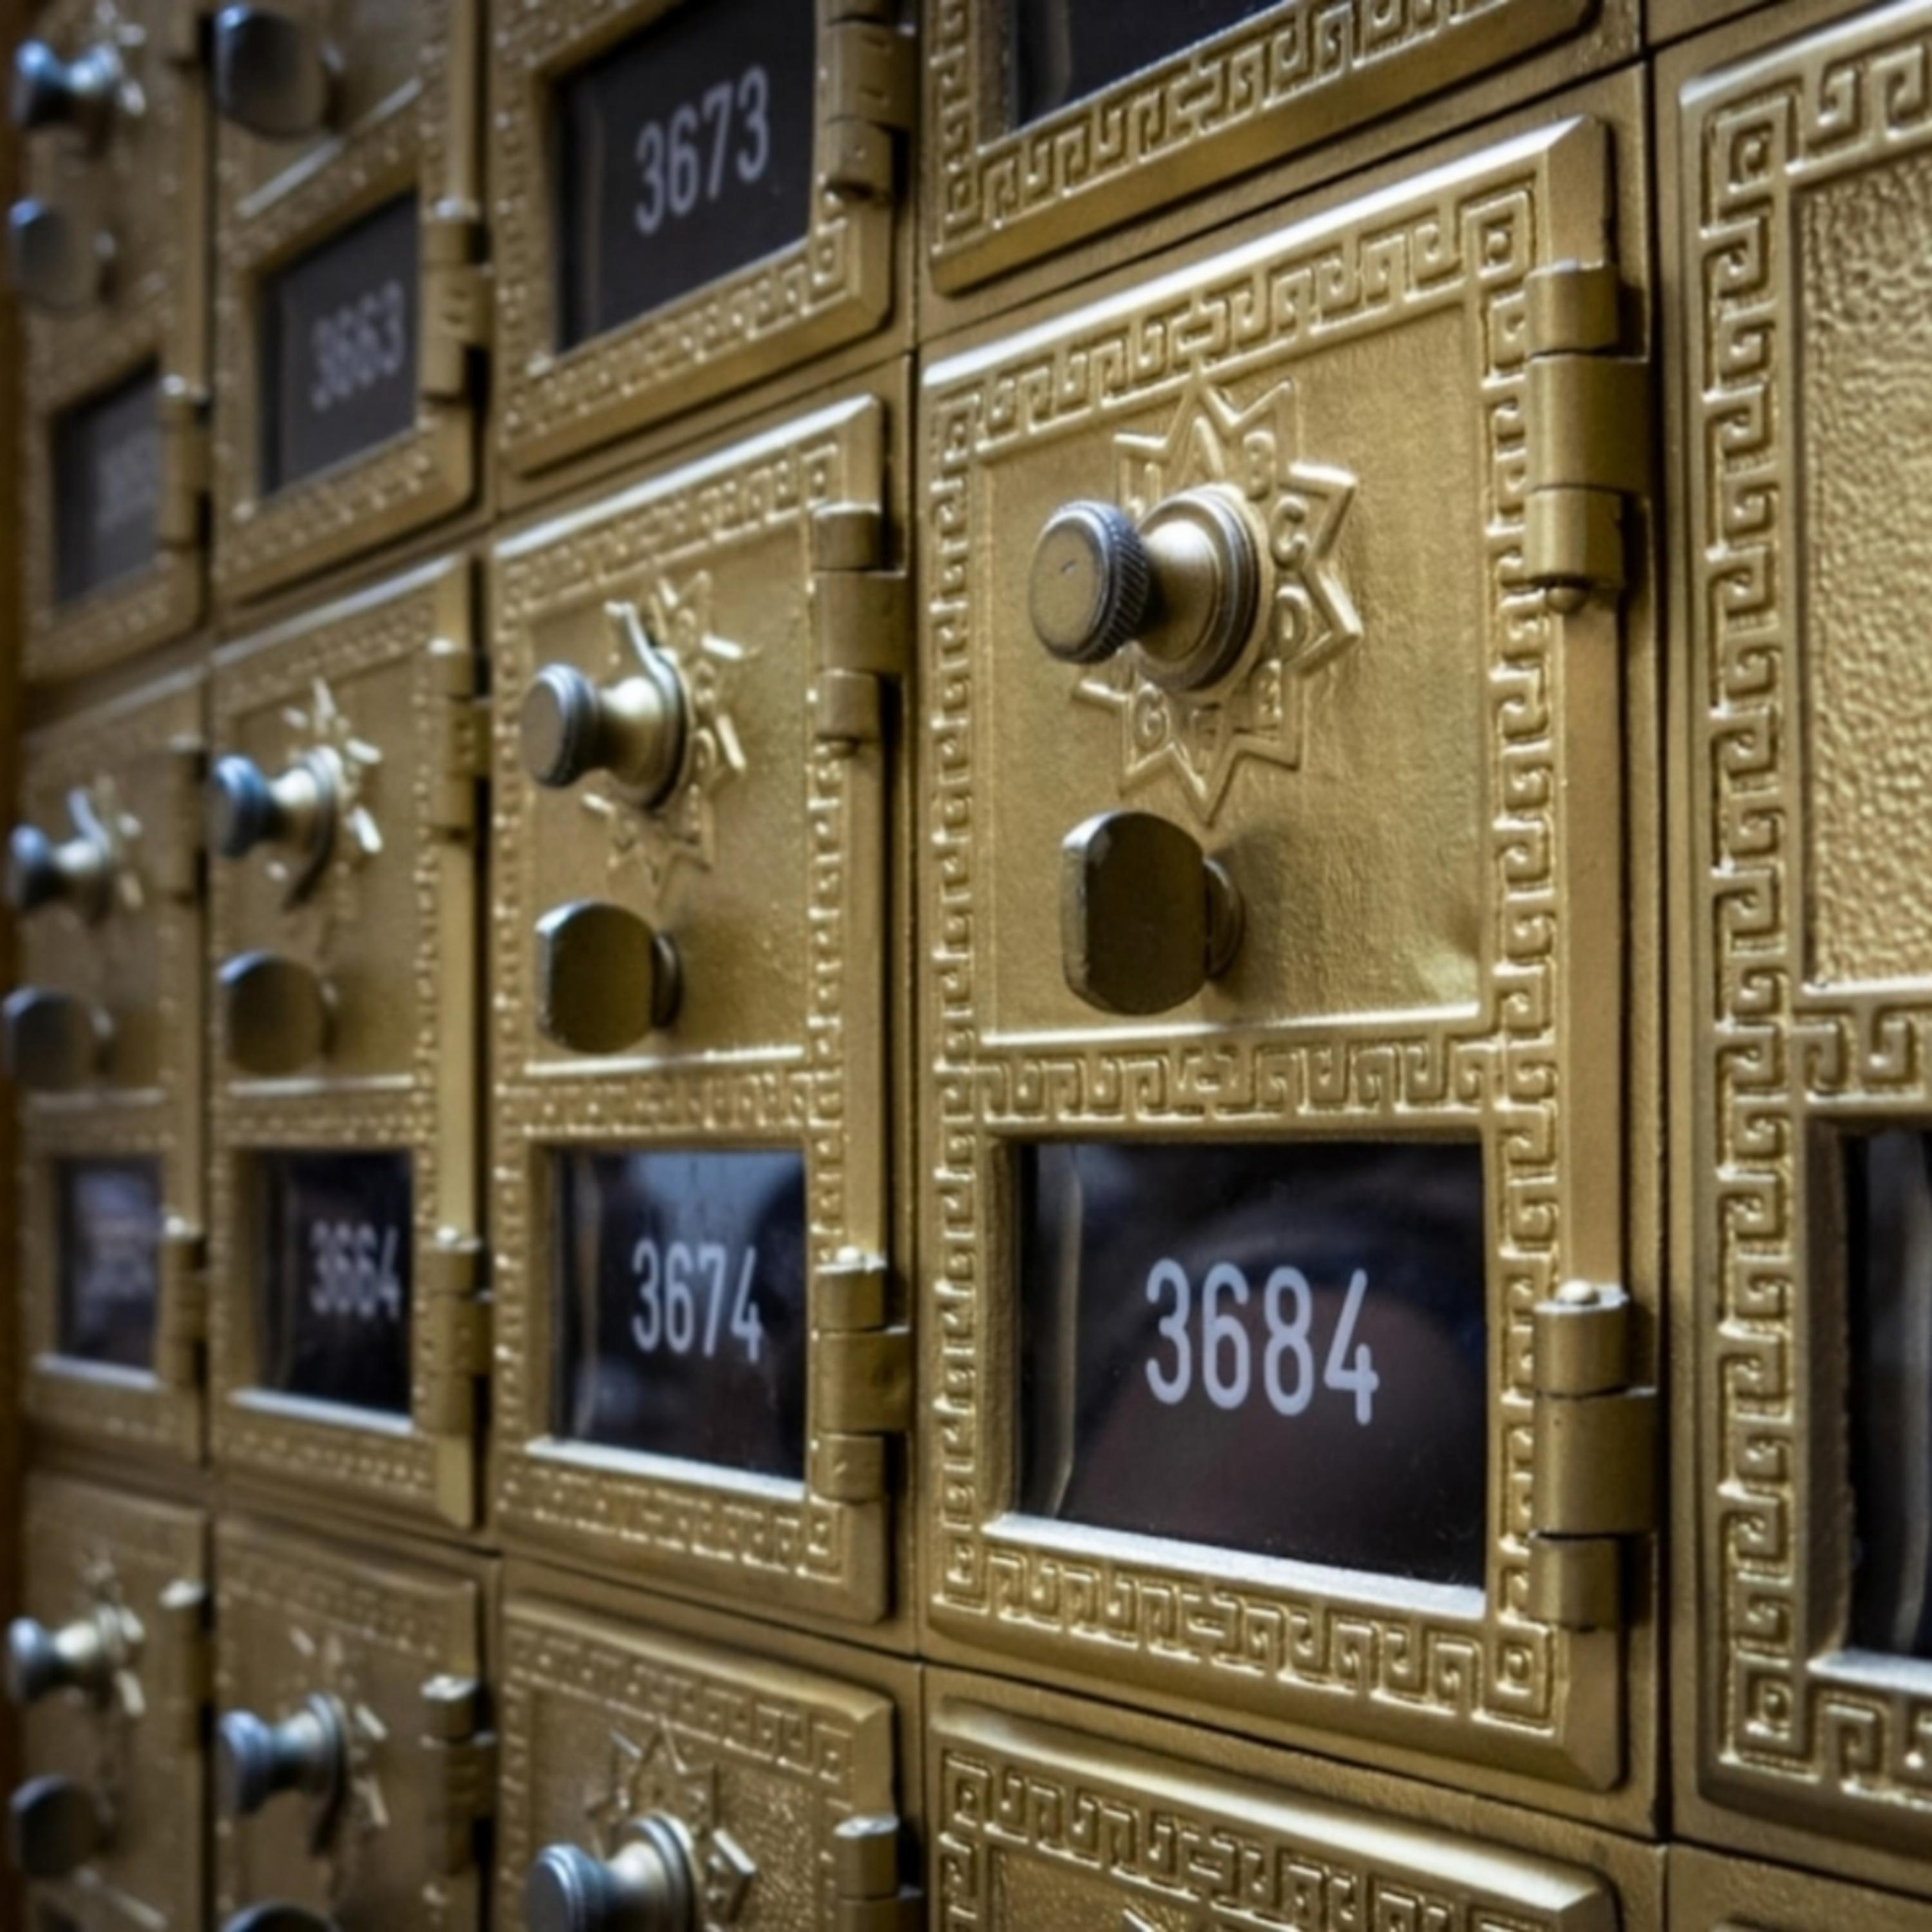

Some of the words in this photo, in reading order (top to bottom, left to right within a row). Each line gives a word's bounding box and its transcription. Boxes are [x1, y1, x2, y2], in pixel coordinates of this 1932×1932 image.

[636, 64, 769, 235] 3673
[310, 1220, 401, 1320] 3664
[632, 1237, 762, 1361] 3674
[1146, 1258, 1379, 1425] 3684
